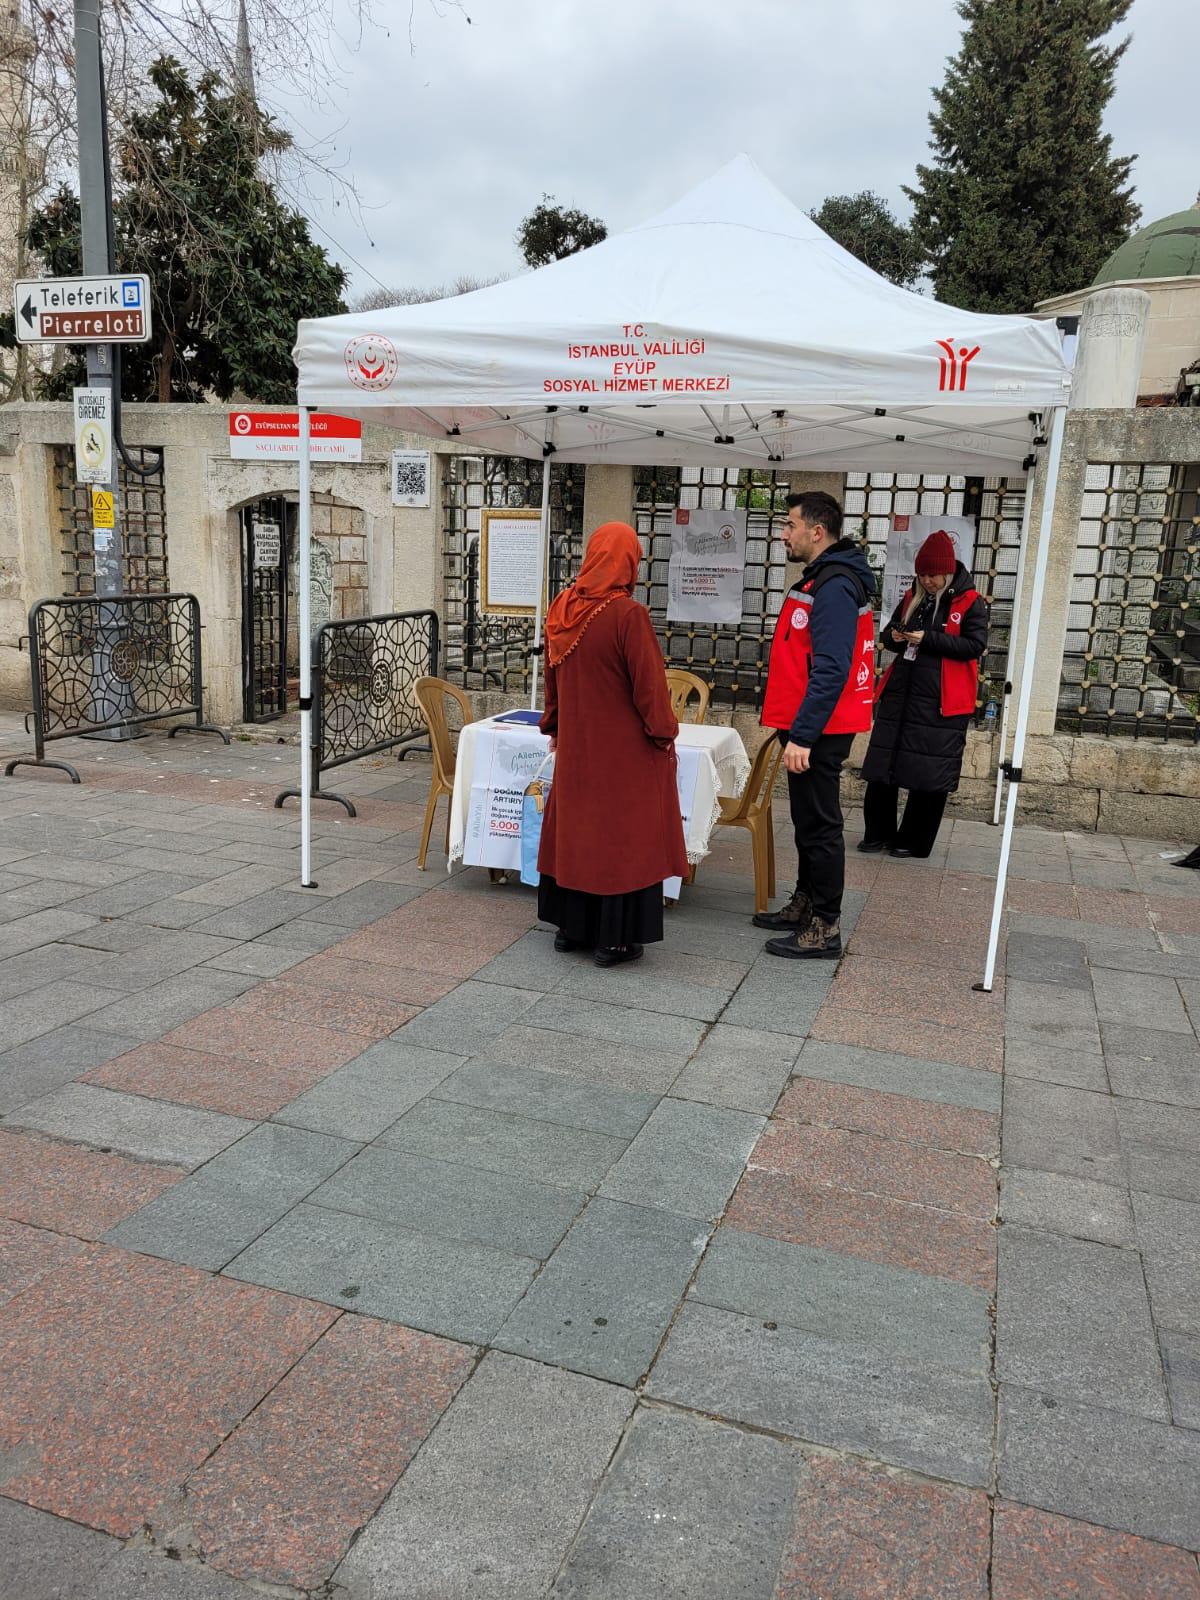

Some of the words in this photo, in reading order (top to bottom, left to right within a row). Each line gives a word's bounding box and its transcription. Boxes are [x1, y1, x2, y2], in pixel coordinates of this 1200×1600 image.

[40, 286, 119, 307] Teleferik
[42, 313, 141, 335] Pierreloti
[622, 324, 648, 338] T.C.
[568, 343, 639, 359] İSTANBUL
[643, 338, 706, 356] VALİLİĞİ
[613, 359, 656, 375] EYÜP
[543, 379, 600, 393] SOSYAL
[604, 376, 658, 392] HİZMET
[662, 374, 731, 392] MERKEZİ
[517, 751, 546, 761] Ailemiz
[493, 787, 523, 797] DOĞUM
[492, 795, 523, 805] ARTIRIY
[490, 819, 520, 830] 5.000
